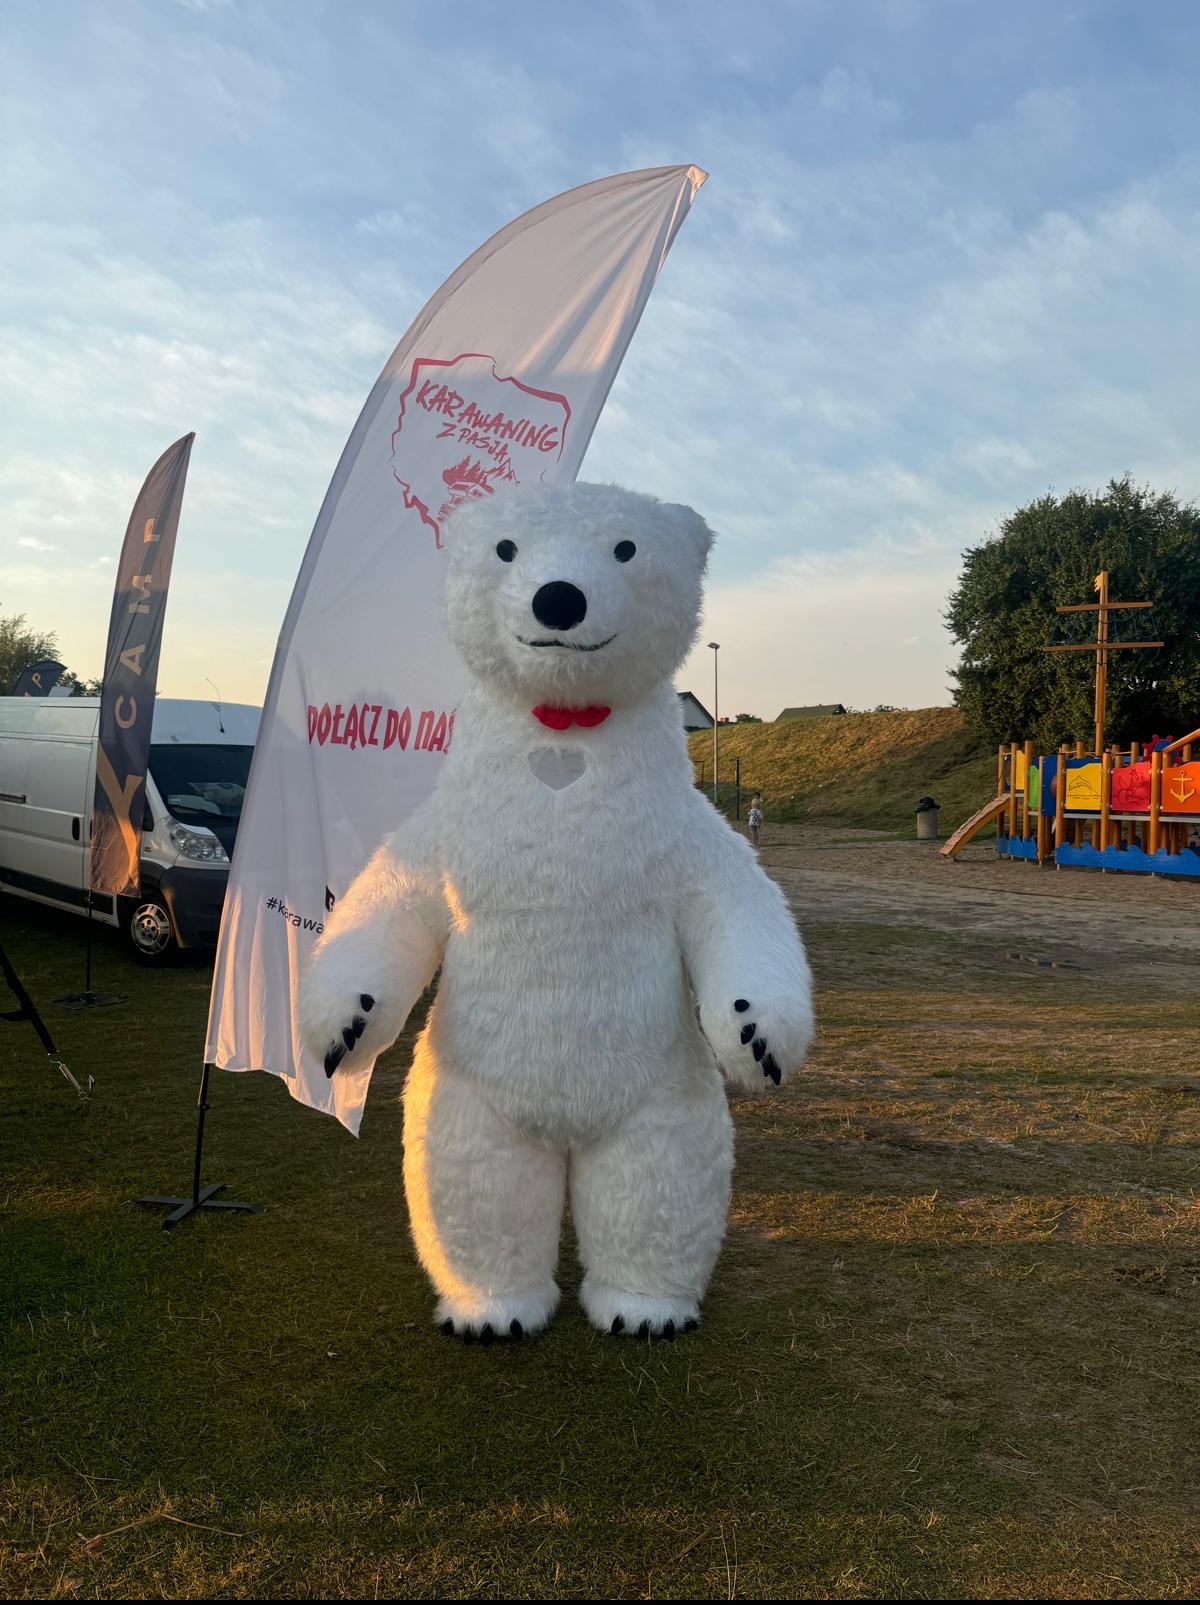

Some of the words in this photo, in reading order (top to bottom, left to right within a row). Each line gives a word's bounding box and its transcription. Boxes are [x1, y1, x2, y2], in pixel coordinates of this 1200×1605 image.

[416, 379, 558, 452] KARAWANING
[436, 422, 457, 438] Z
[114, 517, 161, 729] CAMP
[307, 702, 382, 750] DOŁĄCZ
[383, 706, 412, 751] DO
